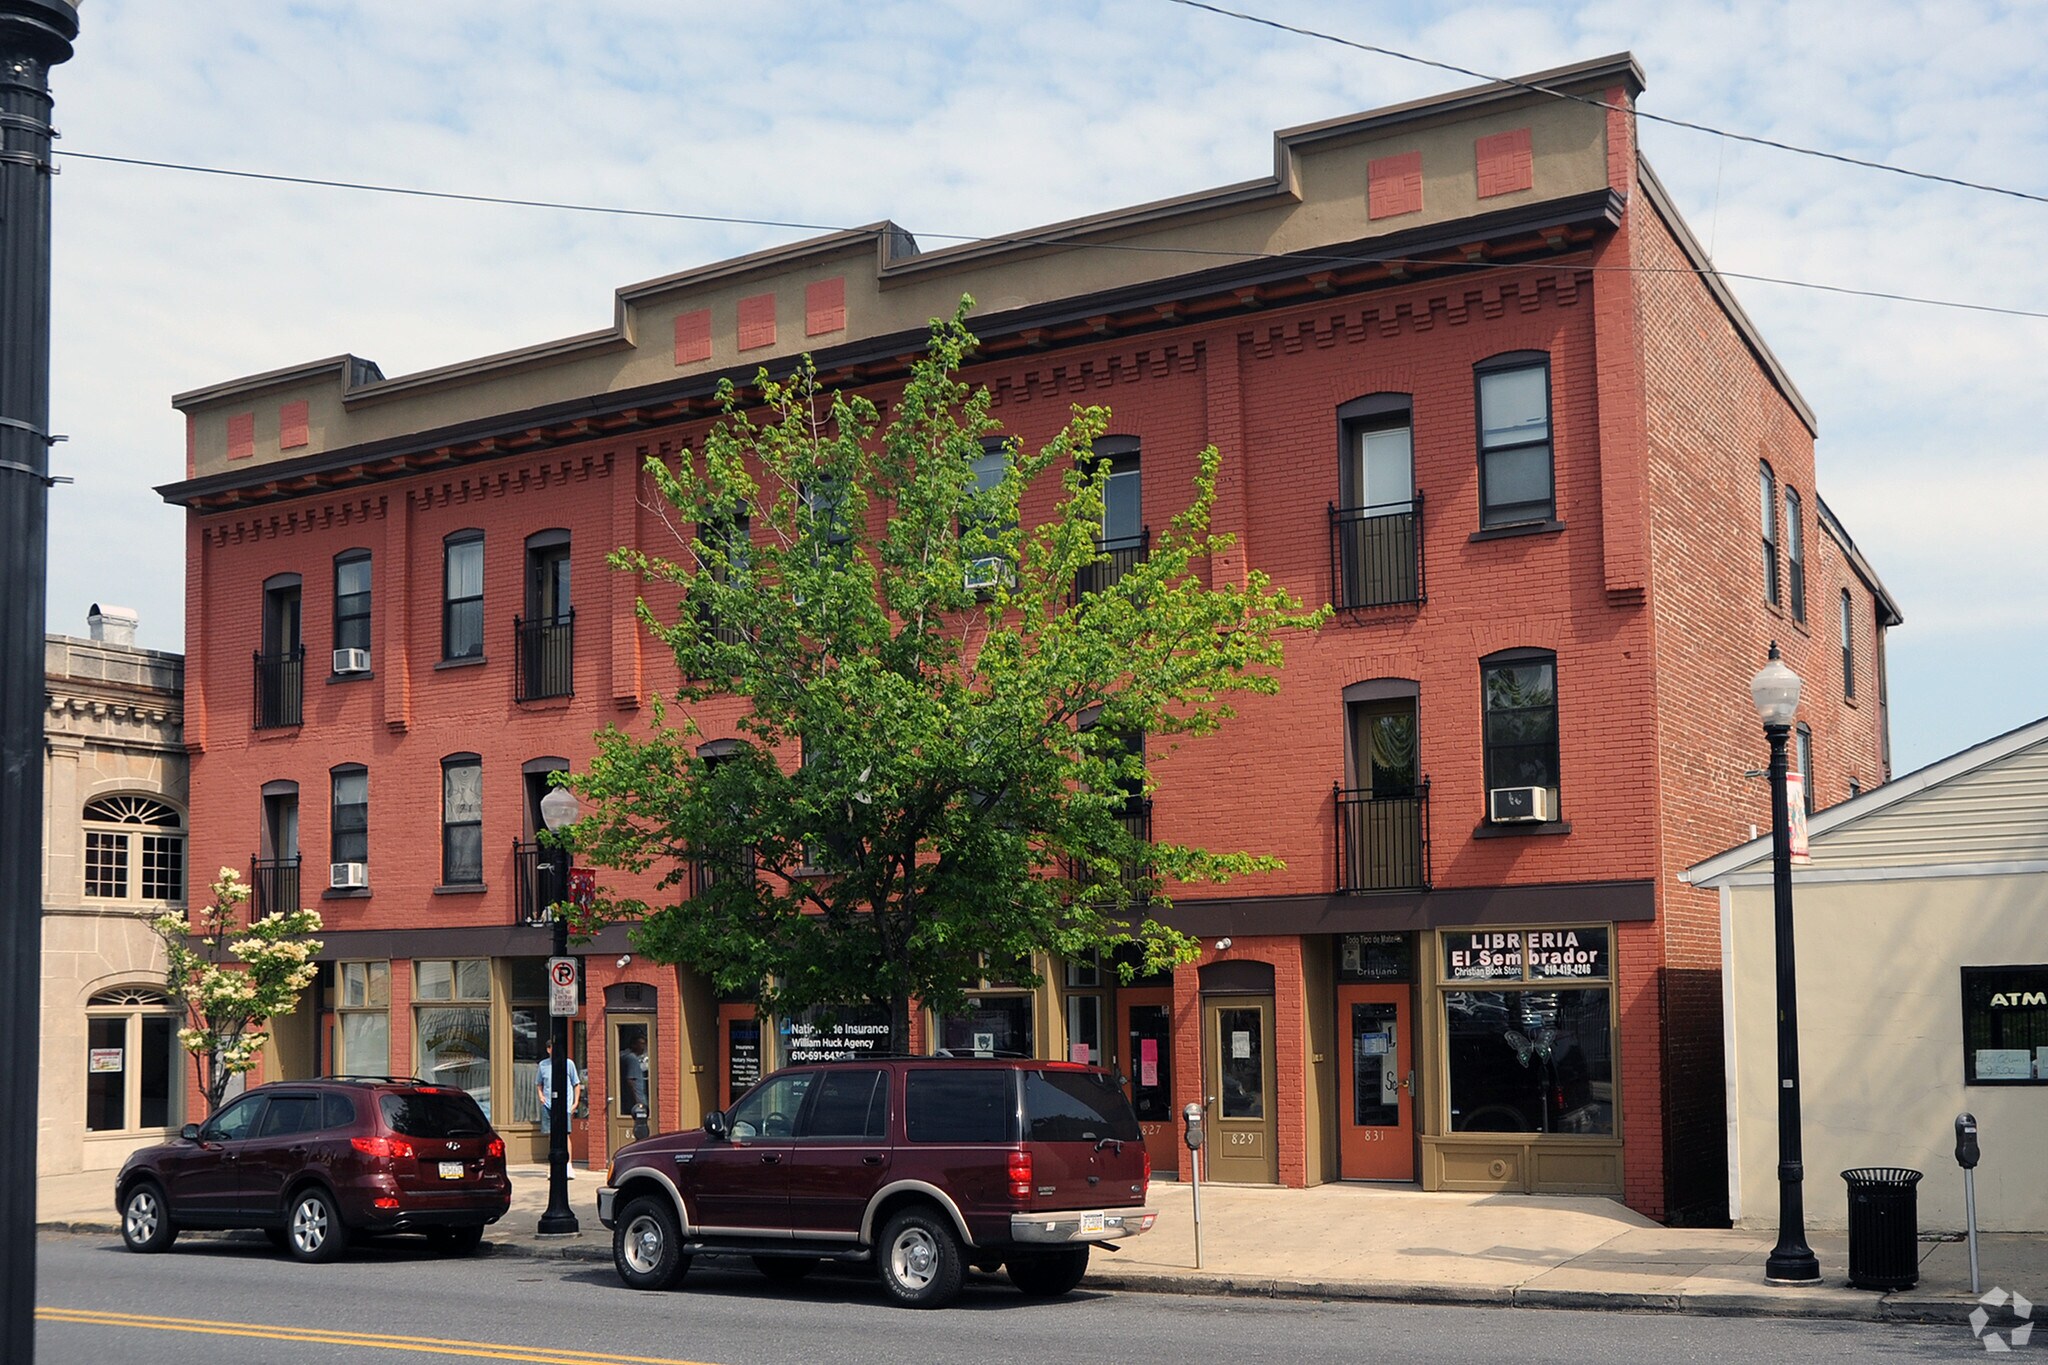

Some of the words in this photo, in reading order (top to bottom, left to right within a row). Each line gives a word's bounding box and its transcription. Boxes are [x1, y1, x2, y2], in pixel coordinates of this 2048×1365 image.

[1471, 931, 1579, 950] LIBRERIA
[1452, 950, 1470, 967] El
[1479, 947, 1598, 967] Sembrador
[1356, 968, 1398, 976] Cristiano
[1454, 966, 1485, 978] Christian
[1485, 965, 1503, 976] Book
[1503, 964, 1522, 975] Store
[1990, 991, 2048, 1007] ATM
[844, 1023, 889, 1034] Insurance
[791, 1036, 821, 1048] William
[822, 1037, 843, 1048] Huck
[843, 1037, 874, 1049] Agency
[1141, 1124, 1162, 1136] 827
[1364, 1129, 1384, 1142] 831
[1231, 1133, 1254, 1145] 829
